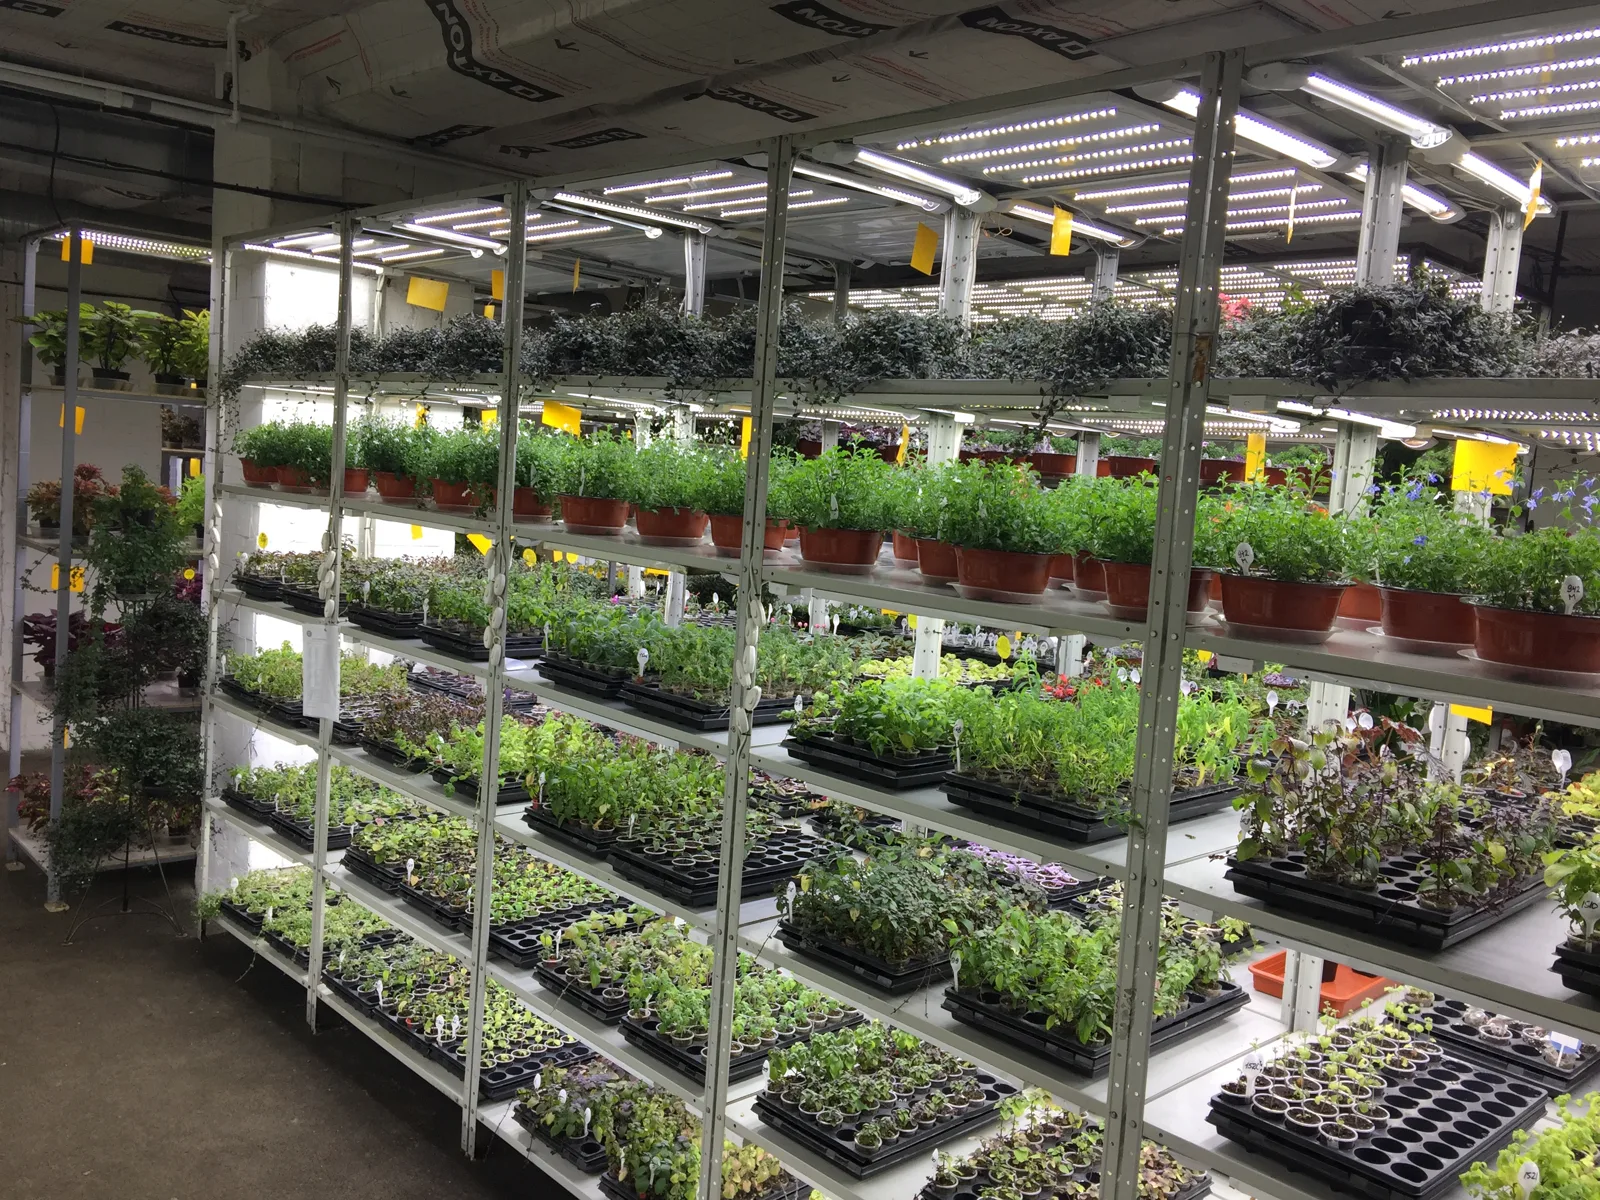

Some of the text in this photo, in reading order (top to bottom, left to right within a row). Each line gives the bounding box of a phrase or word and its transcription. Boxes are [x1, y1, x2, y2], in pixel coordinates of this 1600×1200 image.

[976, 16, 1068, 42] AXTON
[436, 2, 513, 83] AXTON
[712, 89, 779, 108] AXTO
[1566, 585, 1580, 593] 942
